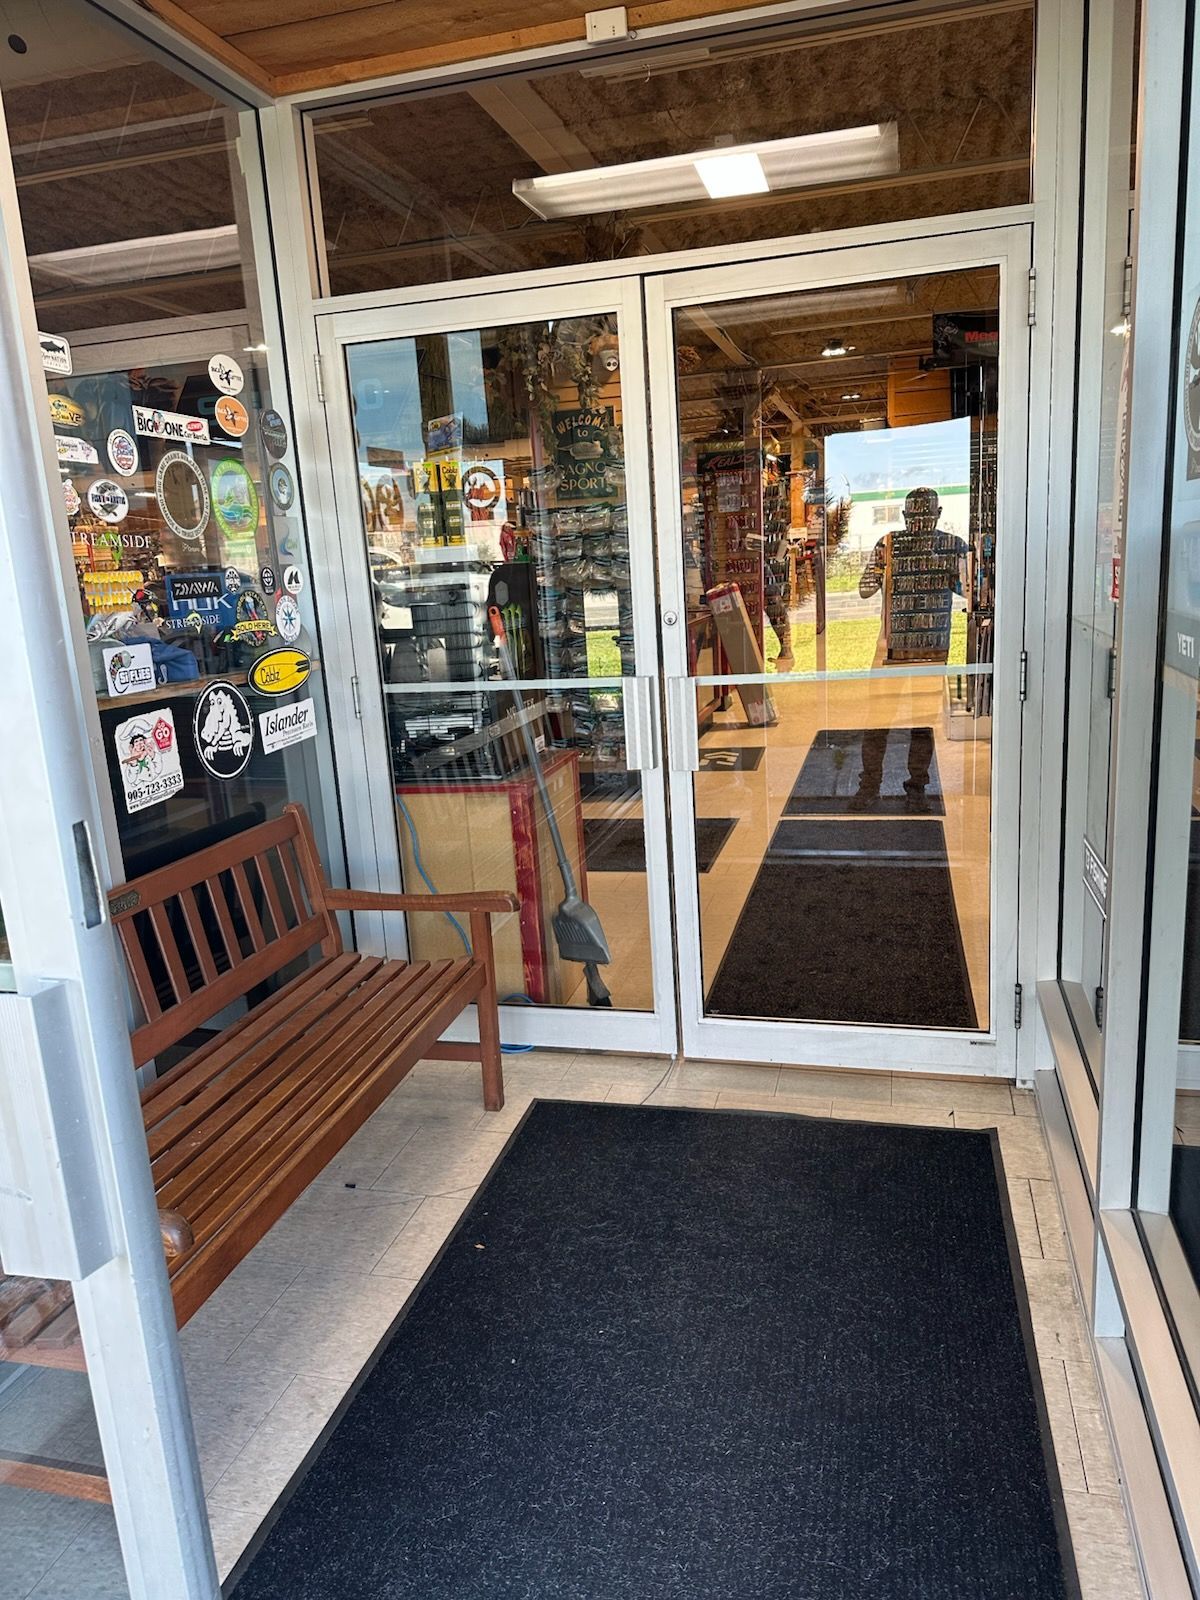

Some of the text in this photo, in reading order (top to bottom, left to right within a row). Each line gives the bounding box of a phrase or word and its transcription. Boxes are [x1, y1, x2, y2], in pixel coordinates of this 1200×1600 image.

[137, 416, 154, 432] BIG
[165, 421, 184, 438] ONE
[577, 429, 588, 437] to
[560, 476, 606, 492] SPORT
[69, 531, 151, 548] TREAMSIDE
[174, 581, 219, 595] DAIWA
[171, 591, 232, 611] HUK
[236, 622, 271, 632] SOLD HERE
[1177, 632, 1194, 658] YETI
[265, 706, 308, 736] Islander
[155, 727, 170, 740] GO
